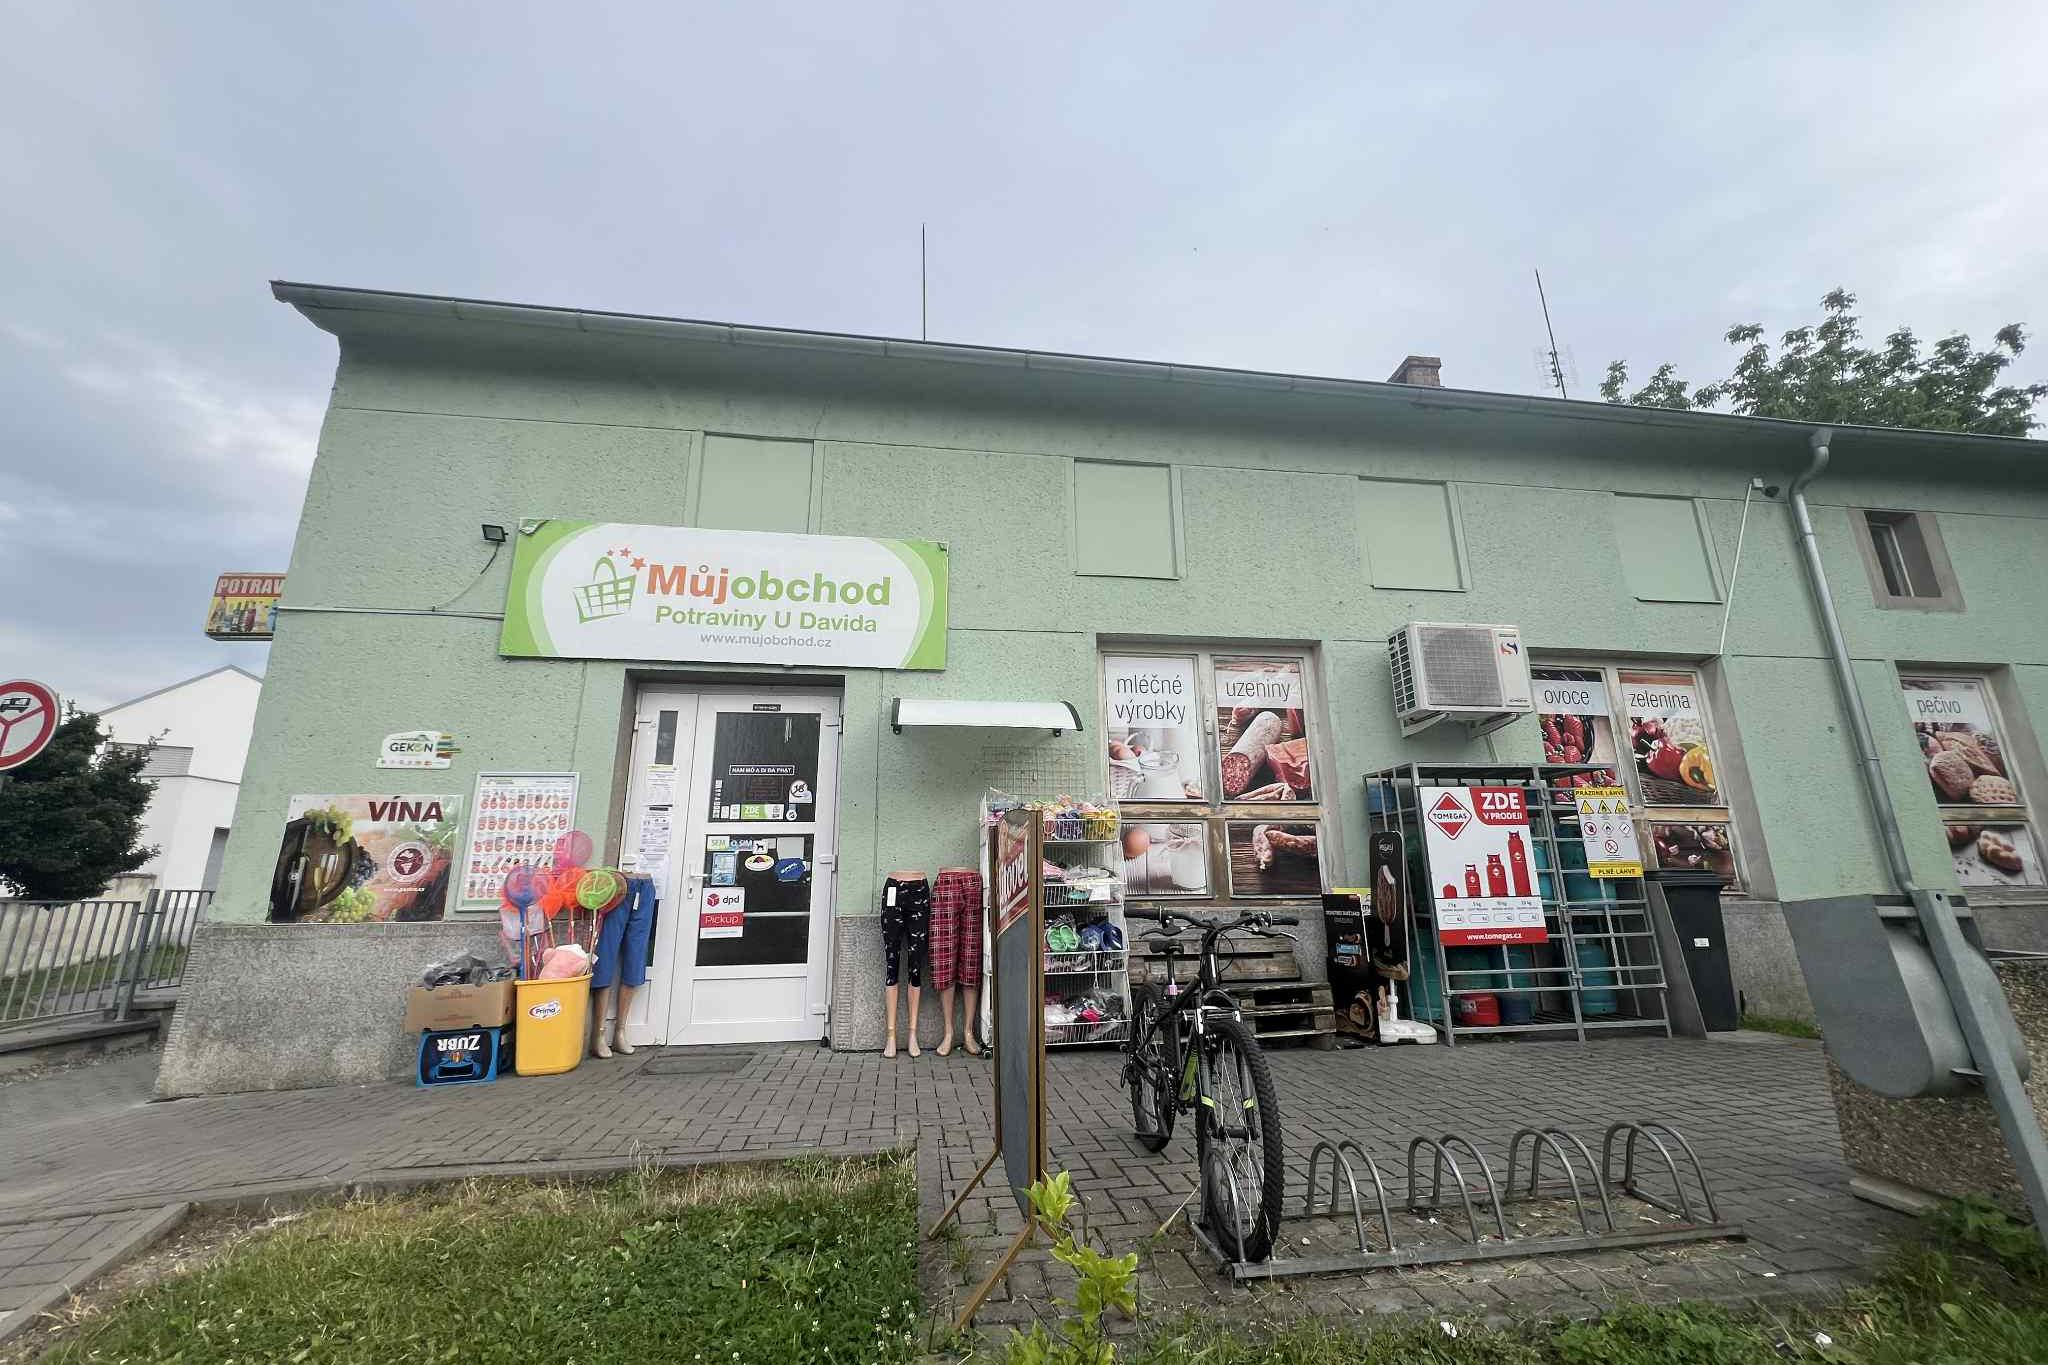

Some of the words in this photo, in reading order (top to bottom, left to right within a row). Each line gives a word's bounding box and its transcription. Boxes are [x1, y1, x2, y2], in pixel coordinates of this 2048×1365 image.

[645, 563, 891, 606] Můjobchod
[655, 605, 766, 631] Potraviny
[774, 611, 792, 629] U
[799, 612, 877, 632] Davida
[700, 632, 832, 648] www.mujobchod.cz
[1116, 674, 1183, 695] mléčné
[1226, 678, 1291, 702] uzeniny
[1544, 688, 1590, 705] ovoce
[1629, 689, 1690, 709] zelenina
[1916, 696, 1961, 716] pečivo
[1115, 699, 1186, 724] výrobky
[368, 796, 444, 822] VÍNA
[1480, 792, 1521, 810] ZDE
[1482, 812, 1489, 820] V
[722, 896, 740, 905] dpd
[704, 914, 739, 925] Pickup
[1466, 932, 1522, 940] www.tomegas.cz
[437, 1034, 481, 1052] ZUBR
